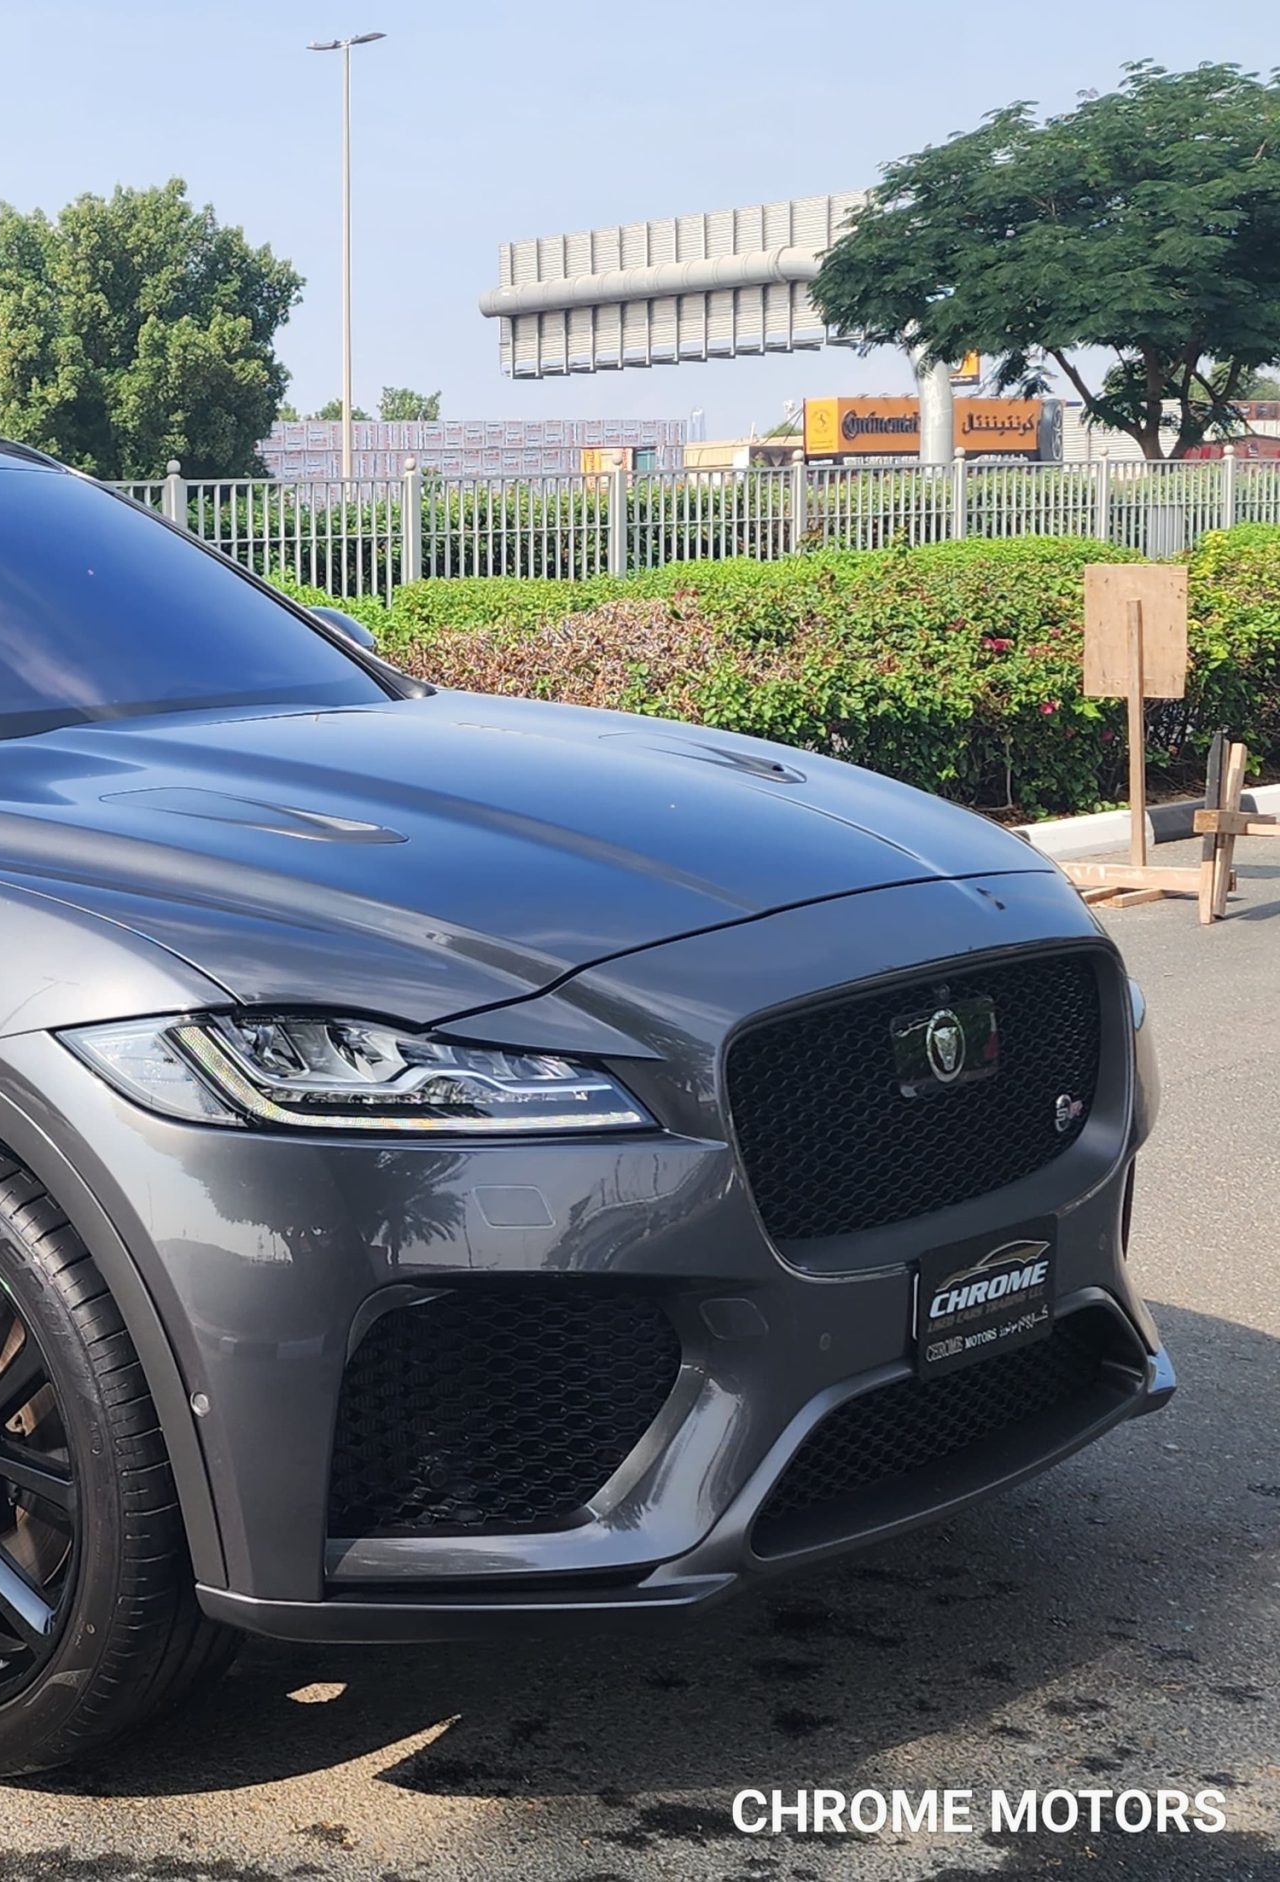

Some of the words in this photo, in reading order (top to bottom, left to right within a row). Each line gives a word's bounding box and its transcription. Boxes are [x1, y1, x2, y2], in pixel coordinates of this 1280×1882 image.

[842, 409, 920, 440] Continental
[929, 1260, 1049, 1319] CHROME
[965, 1328, 997, 1349] MOTORS
